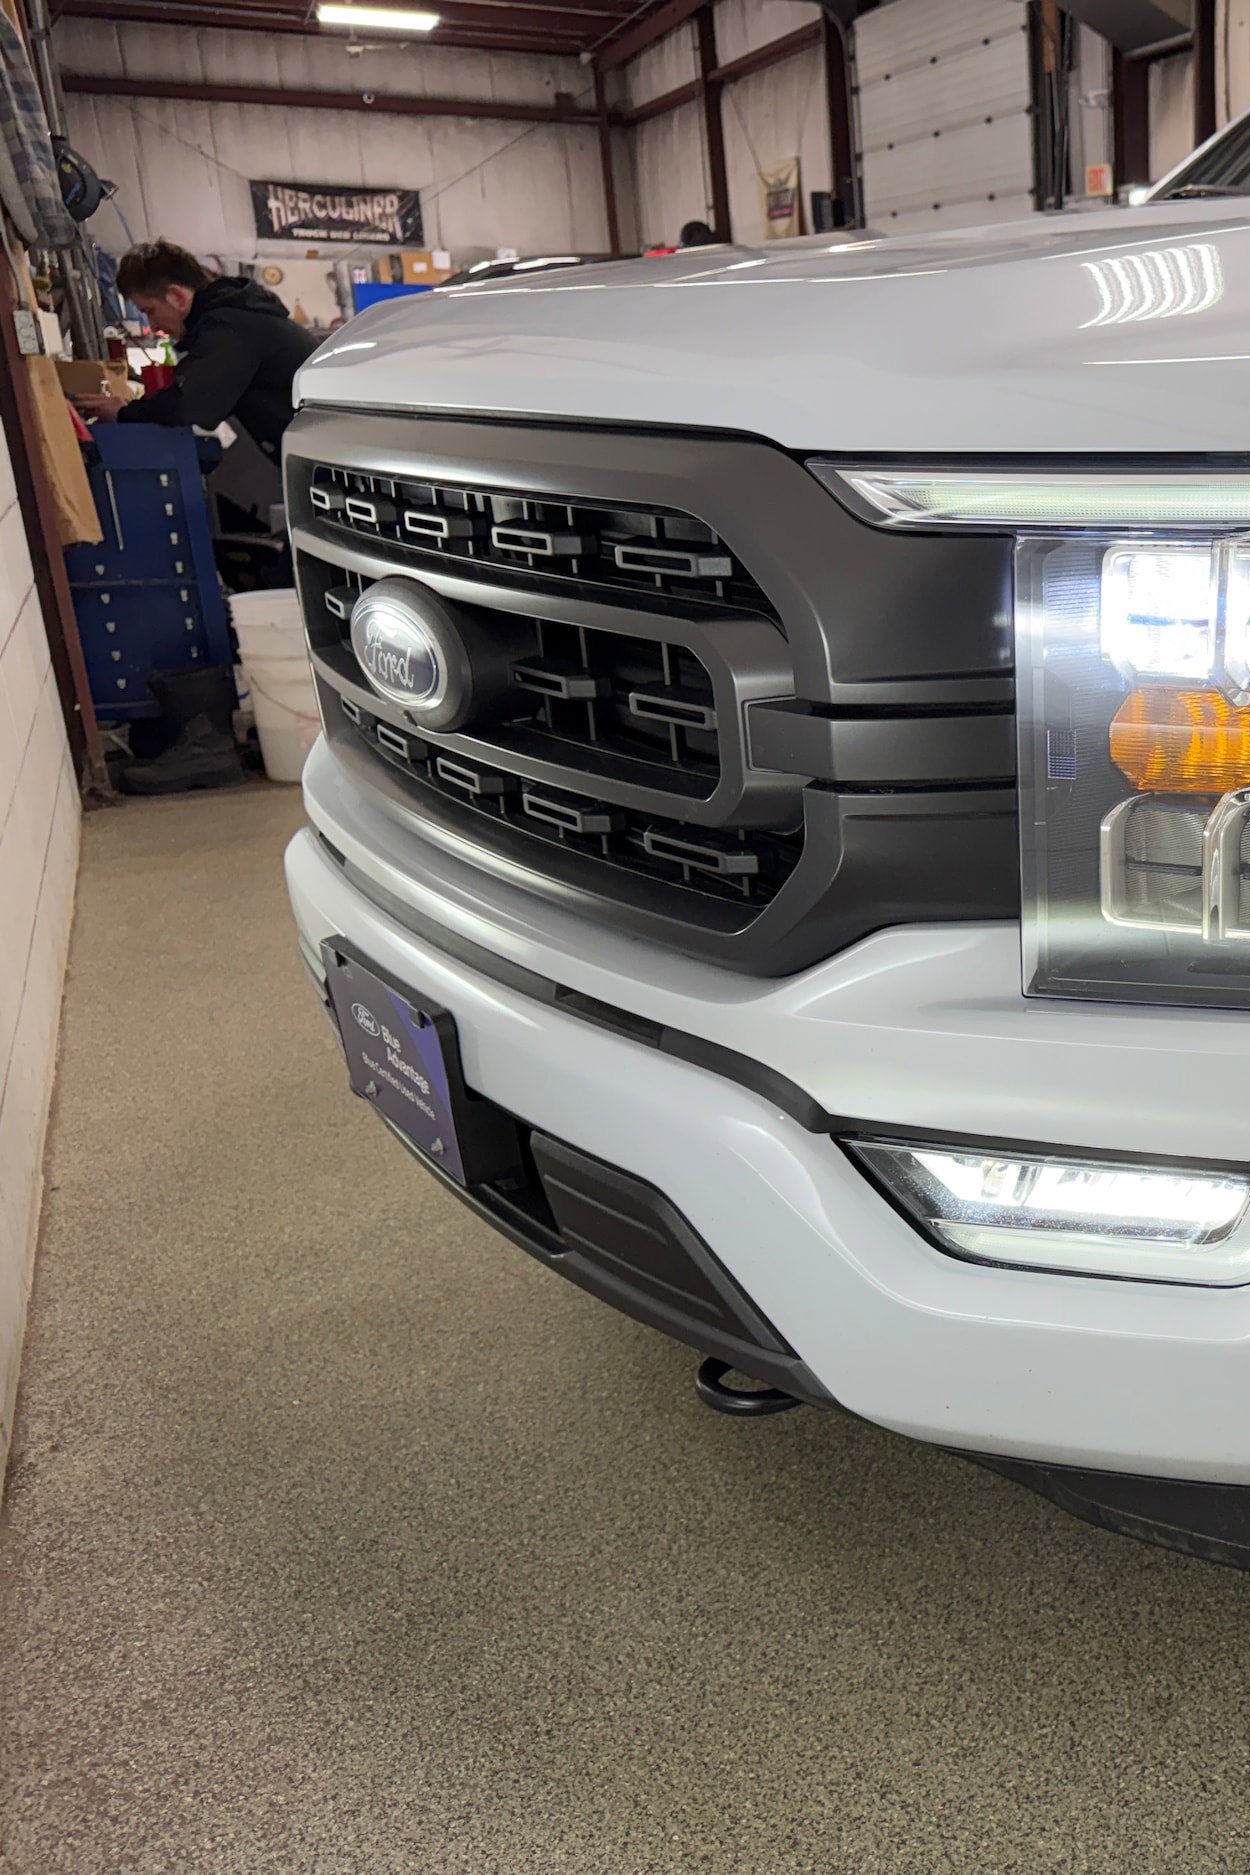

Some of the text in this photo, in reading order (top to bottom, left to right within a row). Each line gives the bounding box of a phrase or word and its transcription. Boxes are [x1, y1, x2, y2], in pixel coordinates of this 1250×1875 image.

[266, 184, 405, 242] HERCULINER
[363, 618, 416, 690] Ford
[380, 1024, 402, 1053] Blue
[386, 1046, 430, 1096] Advantage
